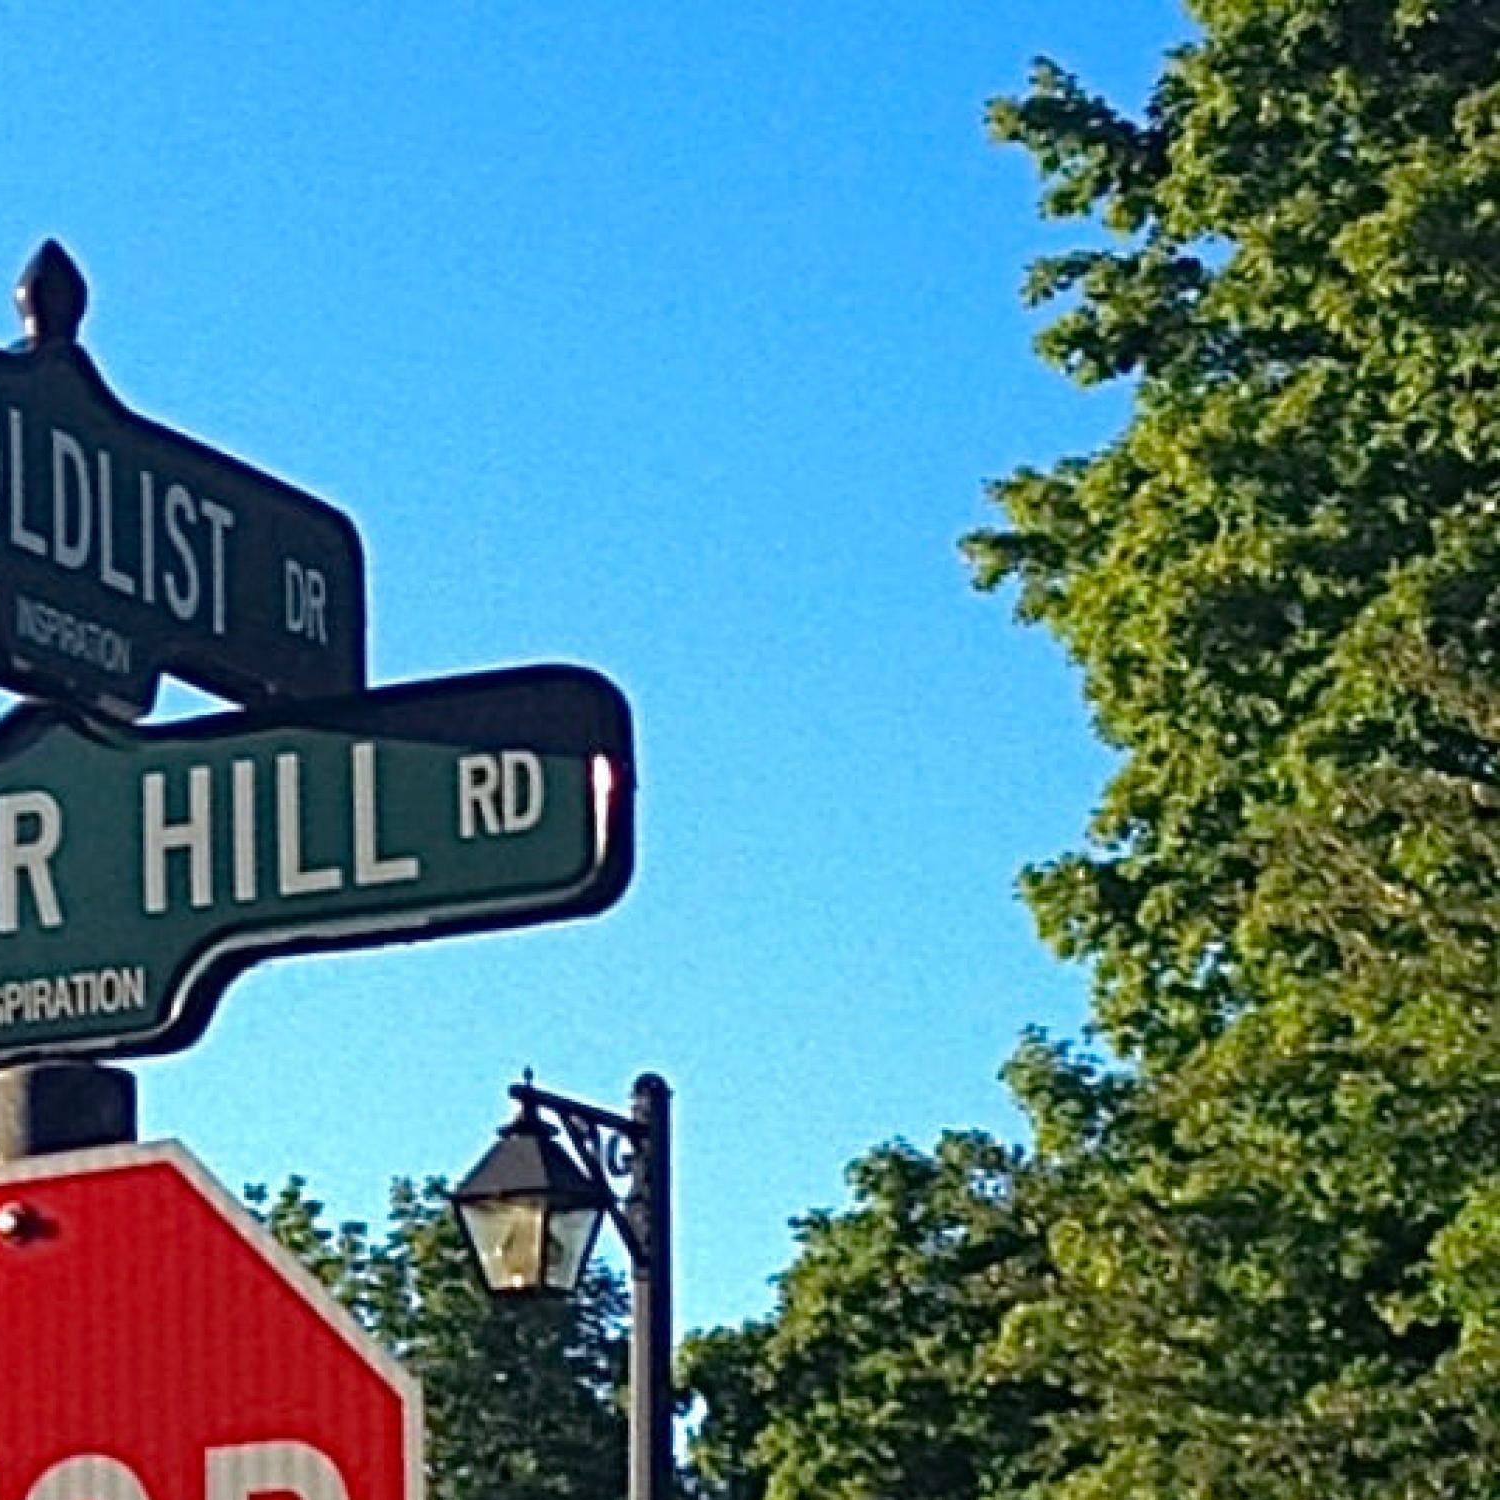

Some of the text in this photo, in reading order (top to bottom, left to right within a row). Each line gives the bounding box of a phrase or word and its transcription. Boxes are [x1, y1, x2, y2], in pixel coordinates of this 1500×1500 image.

[16, 597, 131, 673] INSPIRATION
[285, 558, 327, 645] DR
[142, 742, 419, 915] HILL
[457, 751, 544, 840] RD
